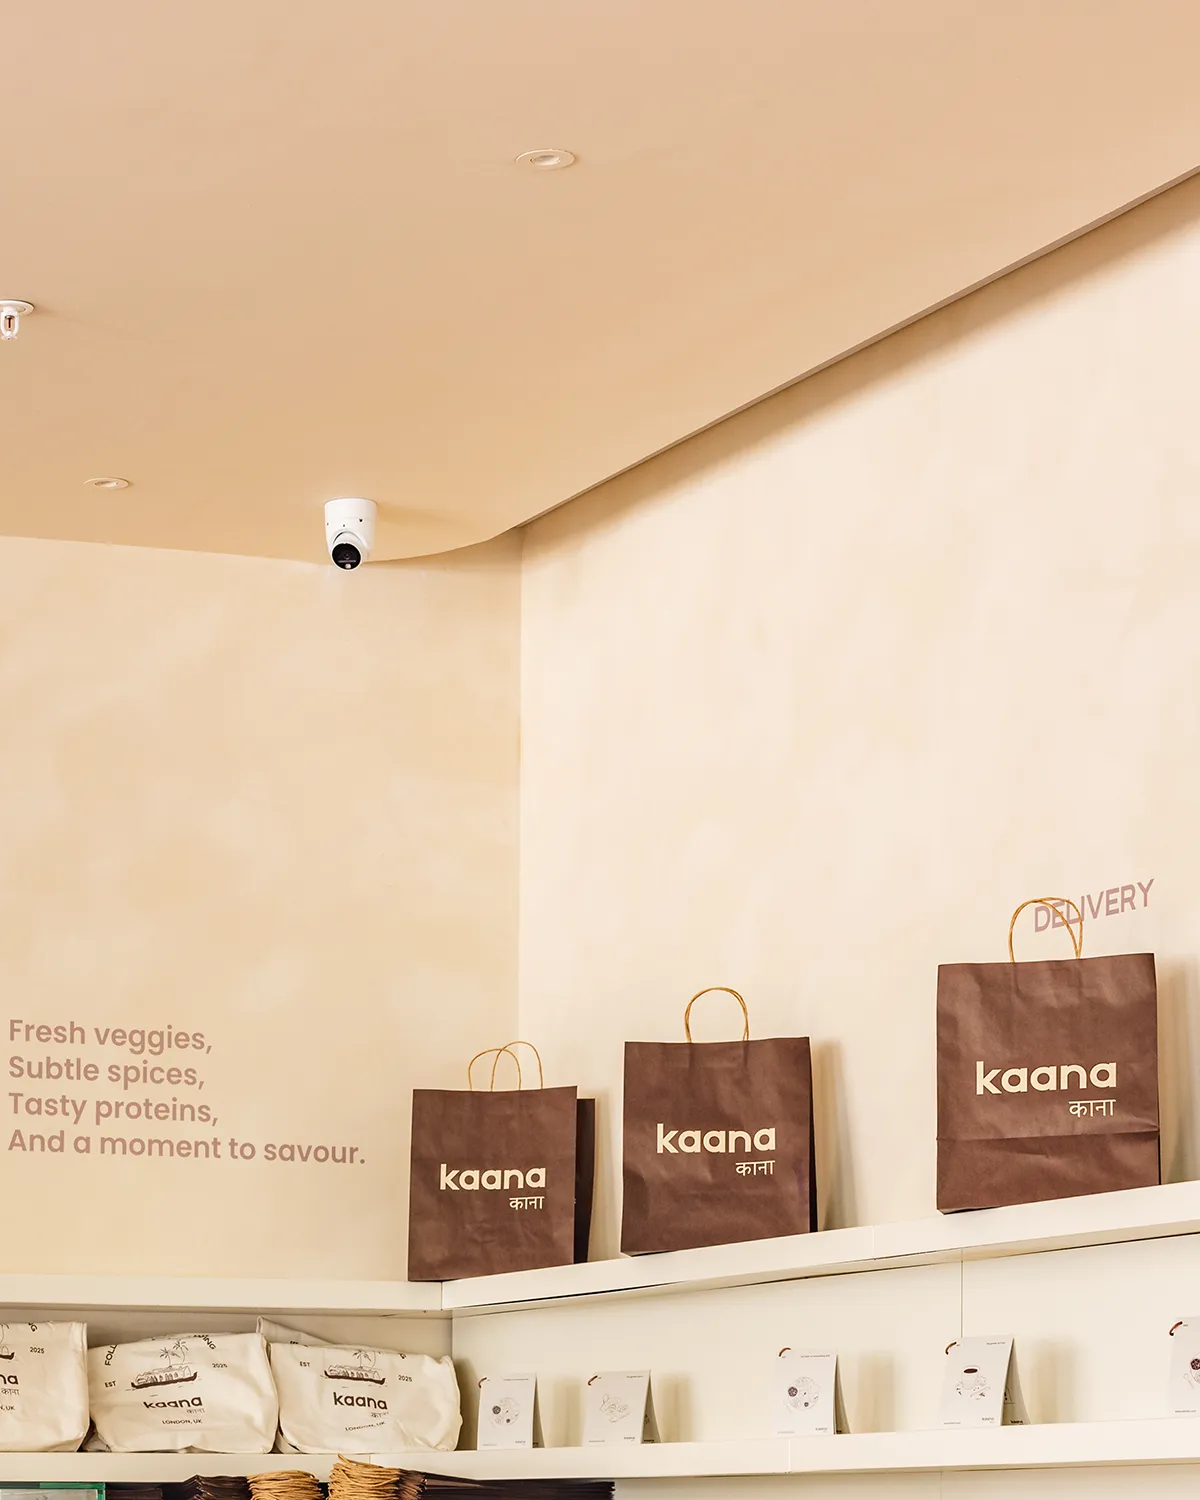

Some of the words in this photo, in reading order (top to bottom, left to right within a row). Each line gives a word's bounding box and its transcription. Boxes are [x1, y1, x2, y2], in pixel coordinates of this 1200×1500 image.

[1034, 878, 1155, 933] DELIVERY
[8, 1019, 86, 1045] Fresh
[94, 1024, 213, 1056] veggies,
[8, 1056, 100, 1082] Subtle
[107, 1061, 205, 1090] spices,
[976, 1060, 1117, 1096] kaana
[8, 1092, 88, 1125] Tasty
[94, 1097, 220, 1127] proteins,
[1068, 1099, 1116, 1118] काना
[8, 1129, 65, 1154] And
[73, 1135, 91, 1154] a
[100, 1134, 221, 1160] moment
[228, 1138, 256, 1161] to
[263, 1141, 366, 1165] savour.
[656, 1123, 776, 1154] kaana
[440, 1164, 546, 1191] kaana
[735, 1160, 776, 1176] काना
[508, 1196, 545, 1211] काना
[30, 1346, 45, 1354] 2025
[104, 1380, 116, 1388] EST
[6, 1404, 16, 1412] UK
[142, 1396, 203, 1410] kaana
[333, 1392, 388, 1410] kaana
